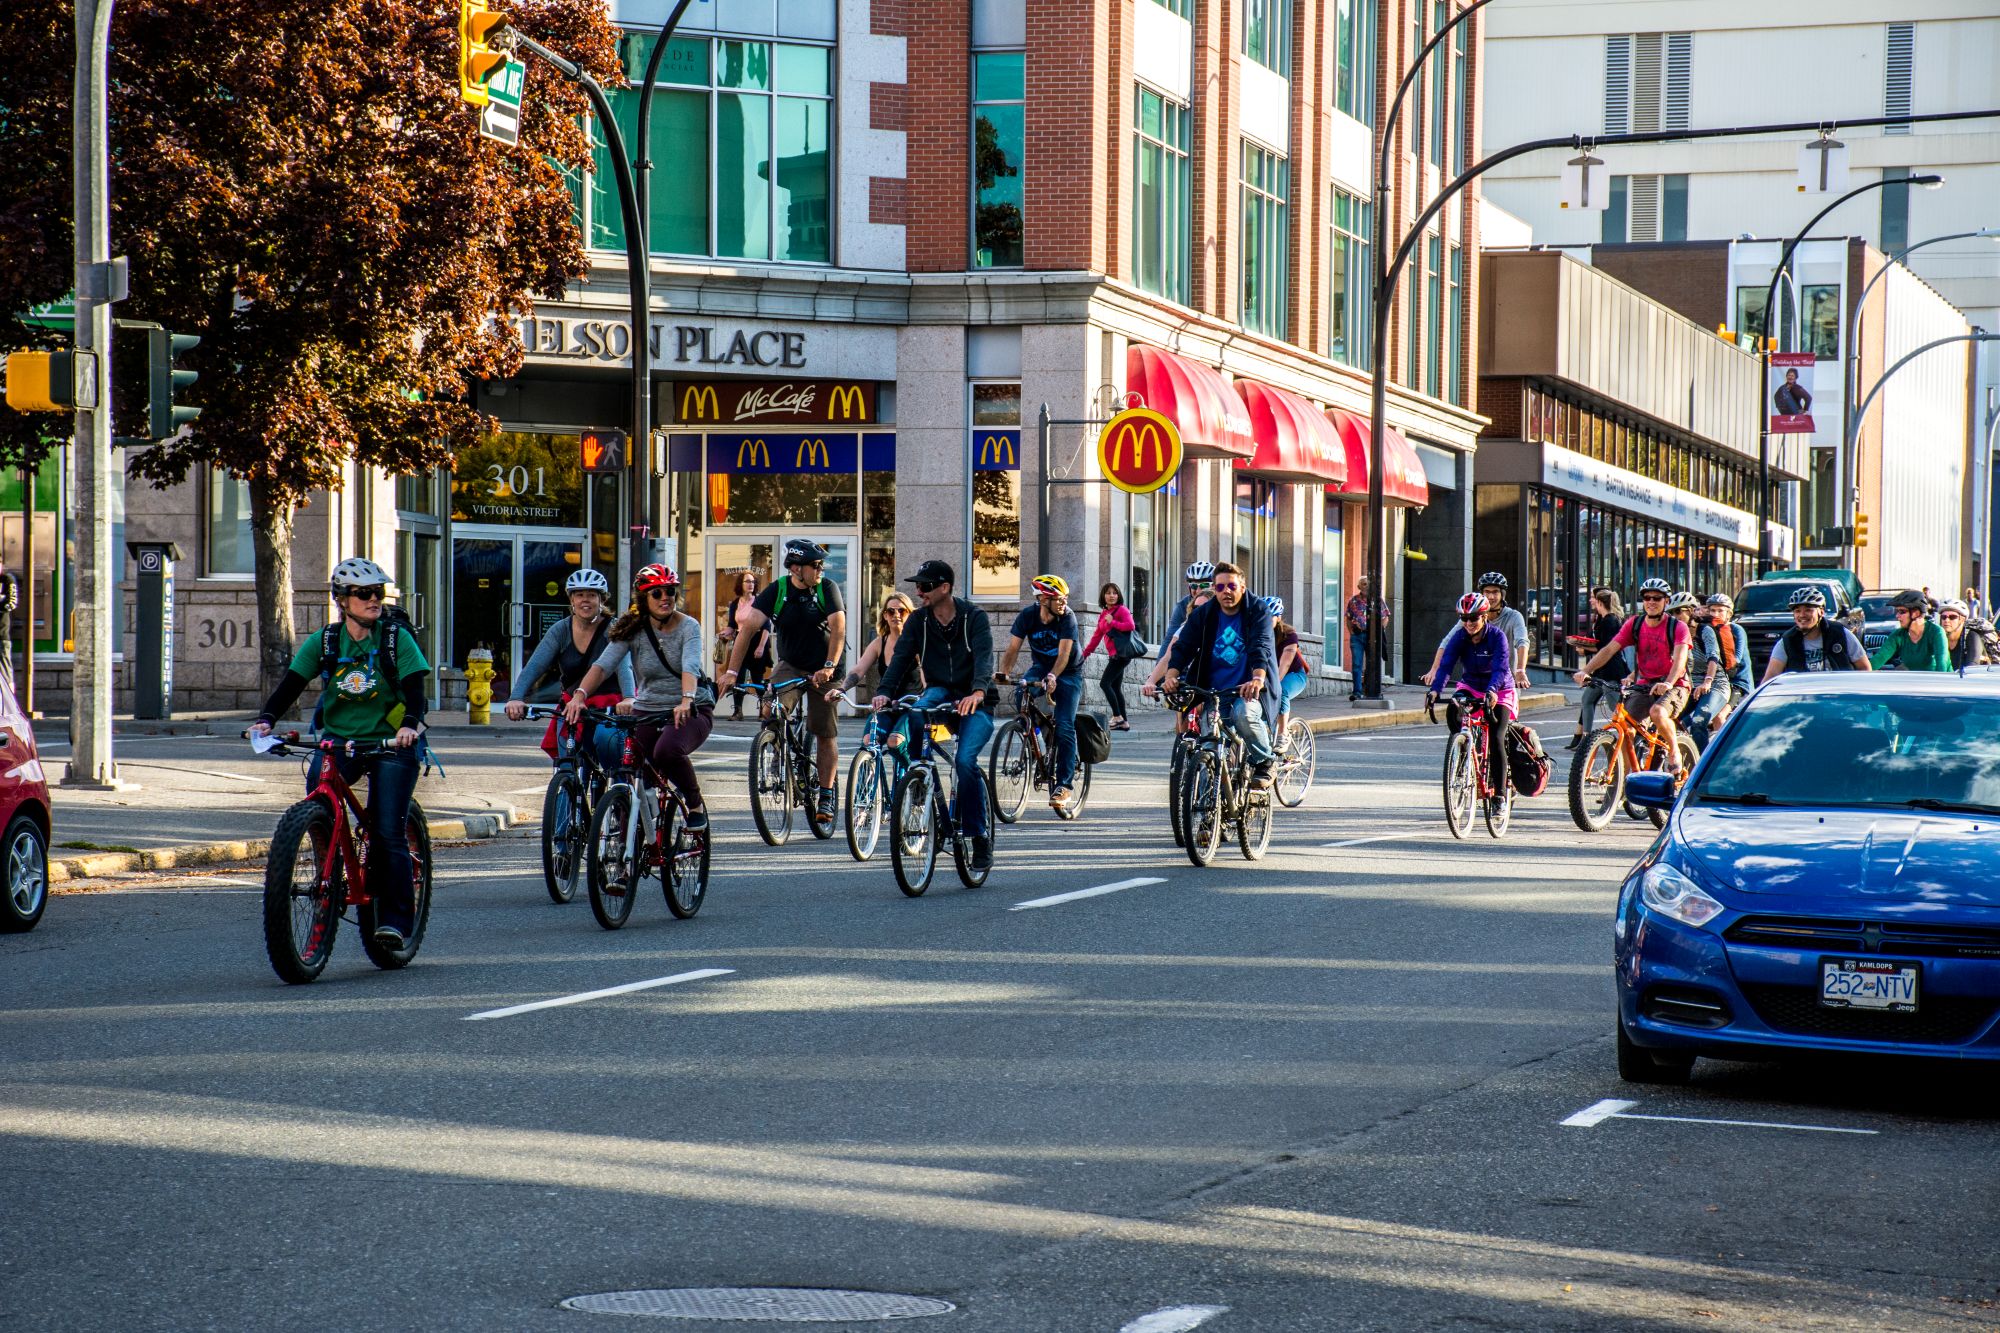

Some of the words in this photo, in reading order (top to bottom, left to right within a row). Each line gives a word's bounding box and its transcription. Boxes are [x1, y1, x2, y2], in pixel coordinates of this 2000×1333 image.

[507, 69, 522, 98] AVE
[675, 325, 806, 368] PLACE
[734, 384, 816, 421] McCafé
[486, 464, 547, 497] 301
[472, 504, 521, 516] VICTORIA
[523, 506, 561, 518] STREET
[198, 619, 257, 649] 301
[1859, 961, 1893, 970] KAMLOOPS
[1825, 972, 1864, 996] 252
[1875, 976, 1914, 1000] NTV
[1896, 1003, 1916, 1013] Jeep
